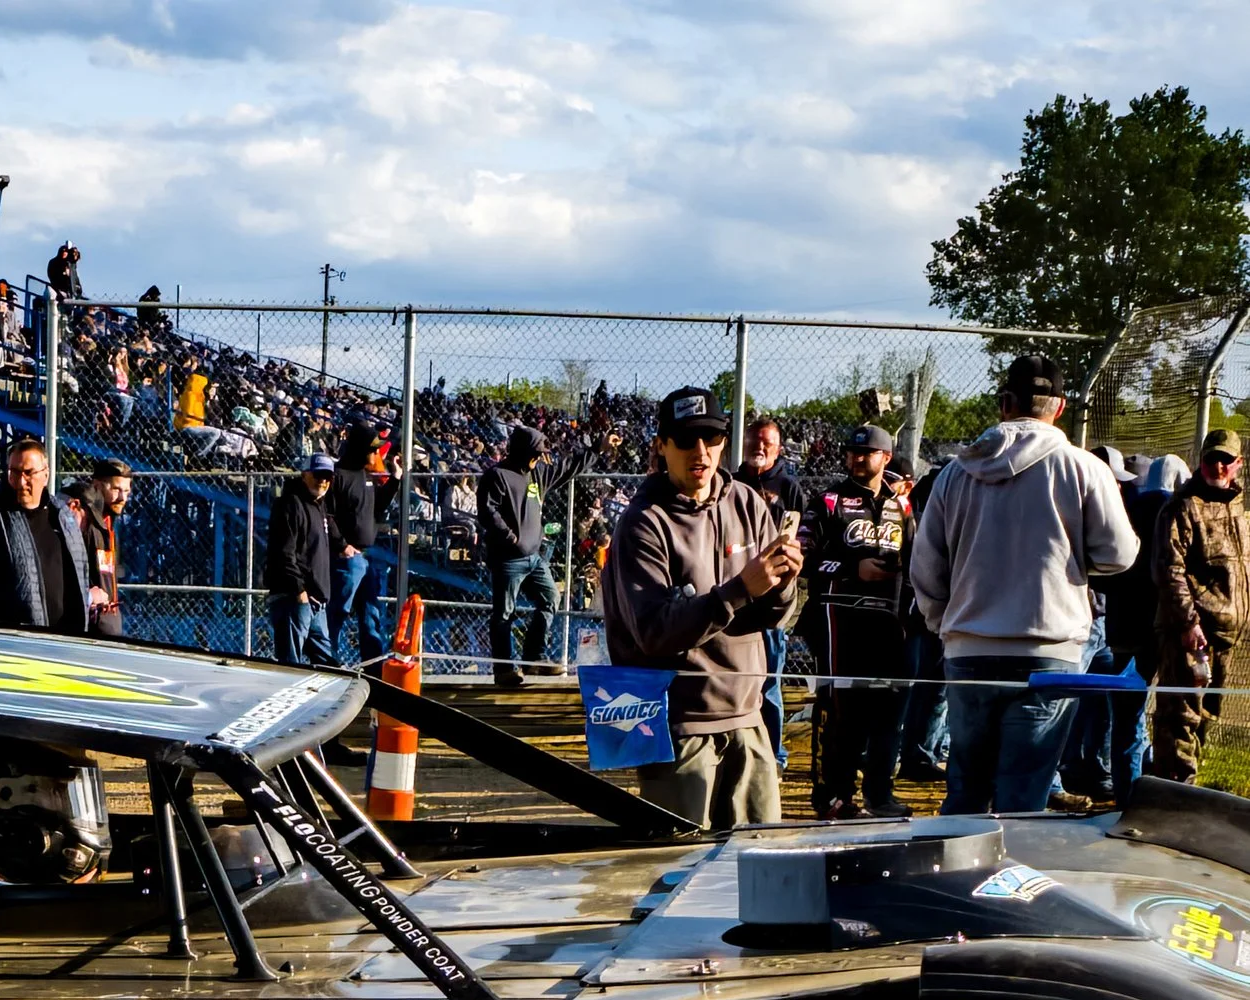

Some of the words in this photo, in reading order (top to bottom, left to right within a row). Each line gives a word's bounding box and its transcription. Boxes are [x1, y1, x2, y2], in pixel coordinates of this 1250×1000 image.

[818, 560, 841, 572] 78
[592, 701, 662, 724] SUNOCO
[372, 896, 429, 948] POWDER
[424, 947, 466, 981] COAT
